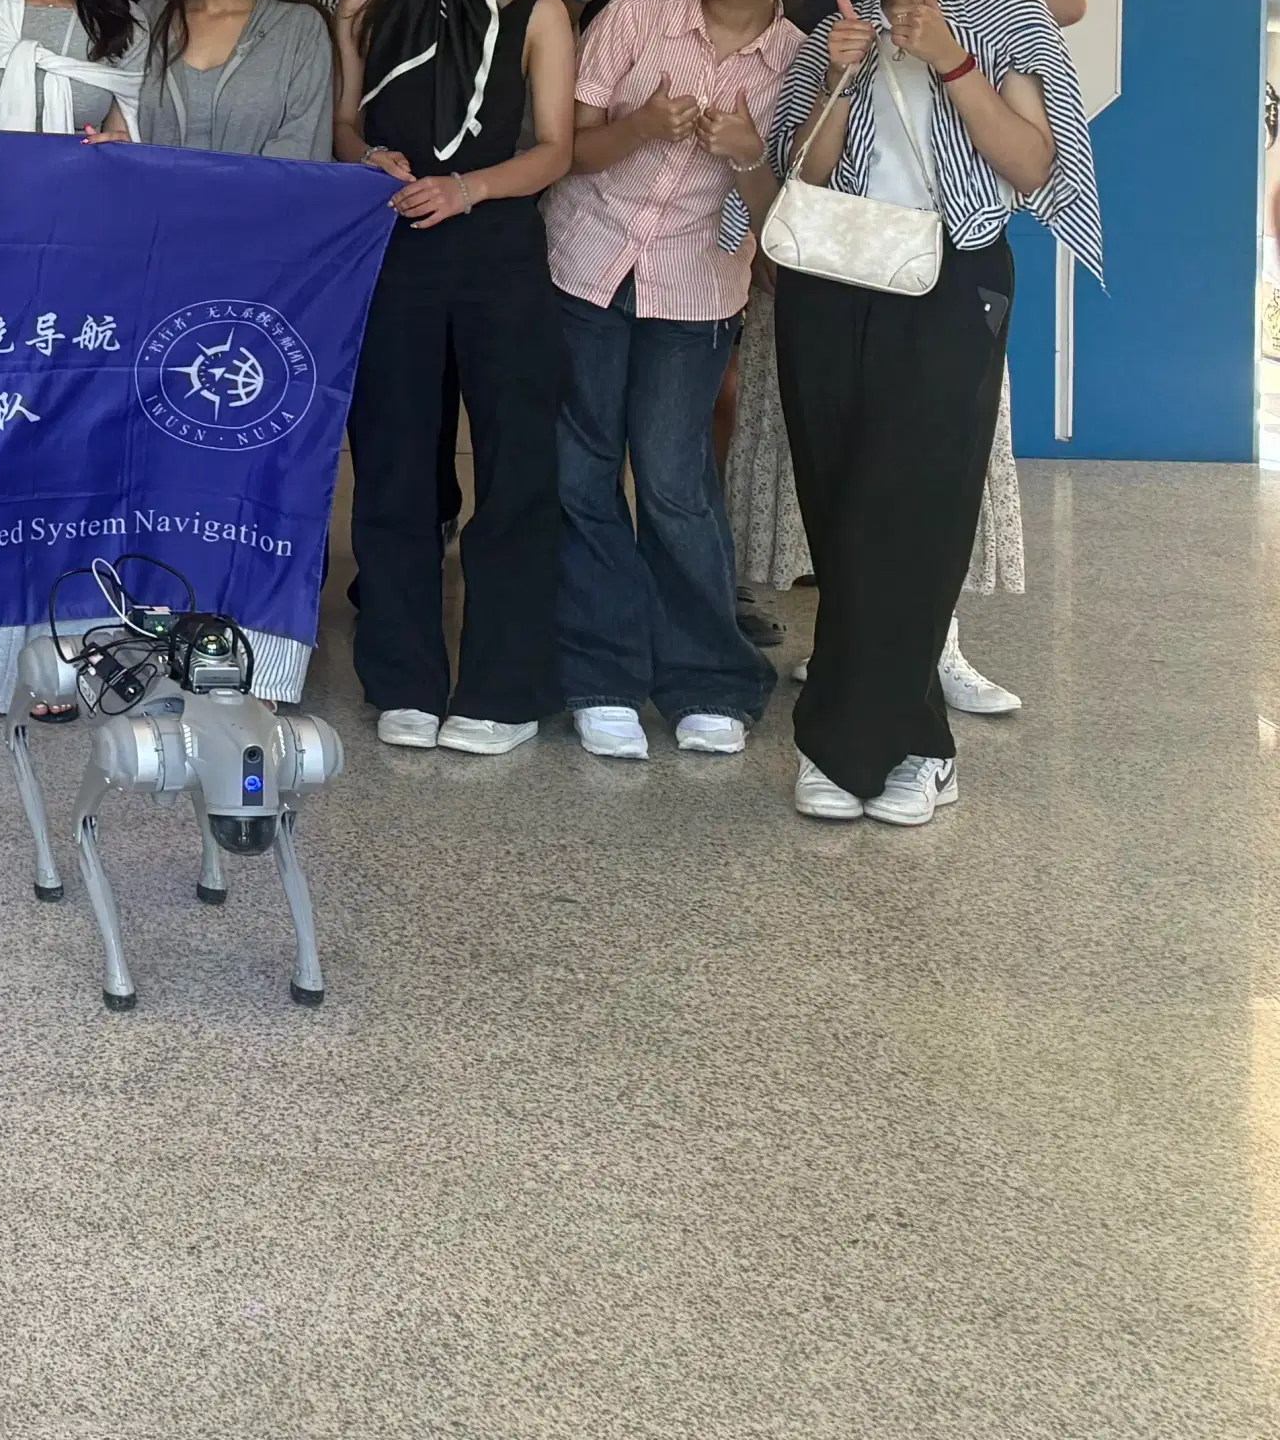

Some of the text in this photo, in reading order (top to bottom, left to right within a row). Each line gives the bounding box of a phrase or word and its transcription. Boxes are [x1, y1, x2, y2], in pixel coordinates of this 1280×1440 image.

[145, 394, 295, 446] IWUSN NUAA
[30, 514, 127, 545] System
[132, 509, 293, 557] Navigation
